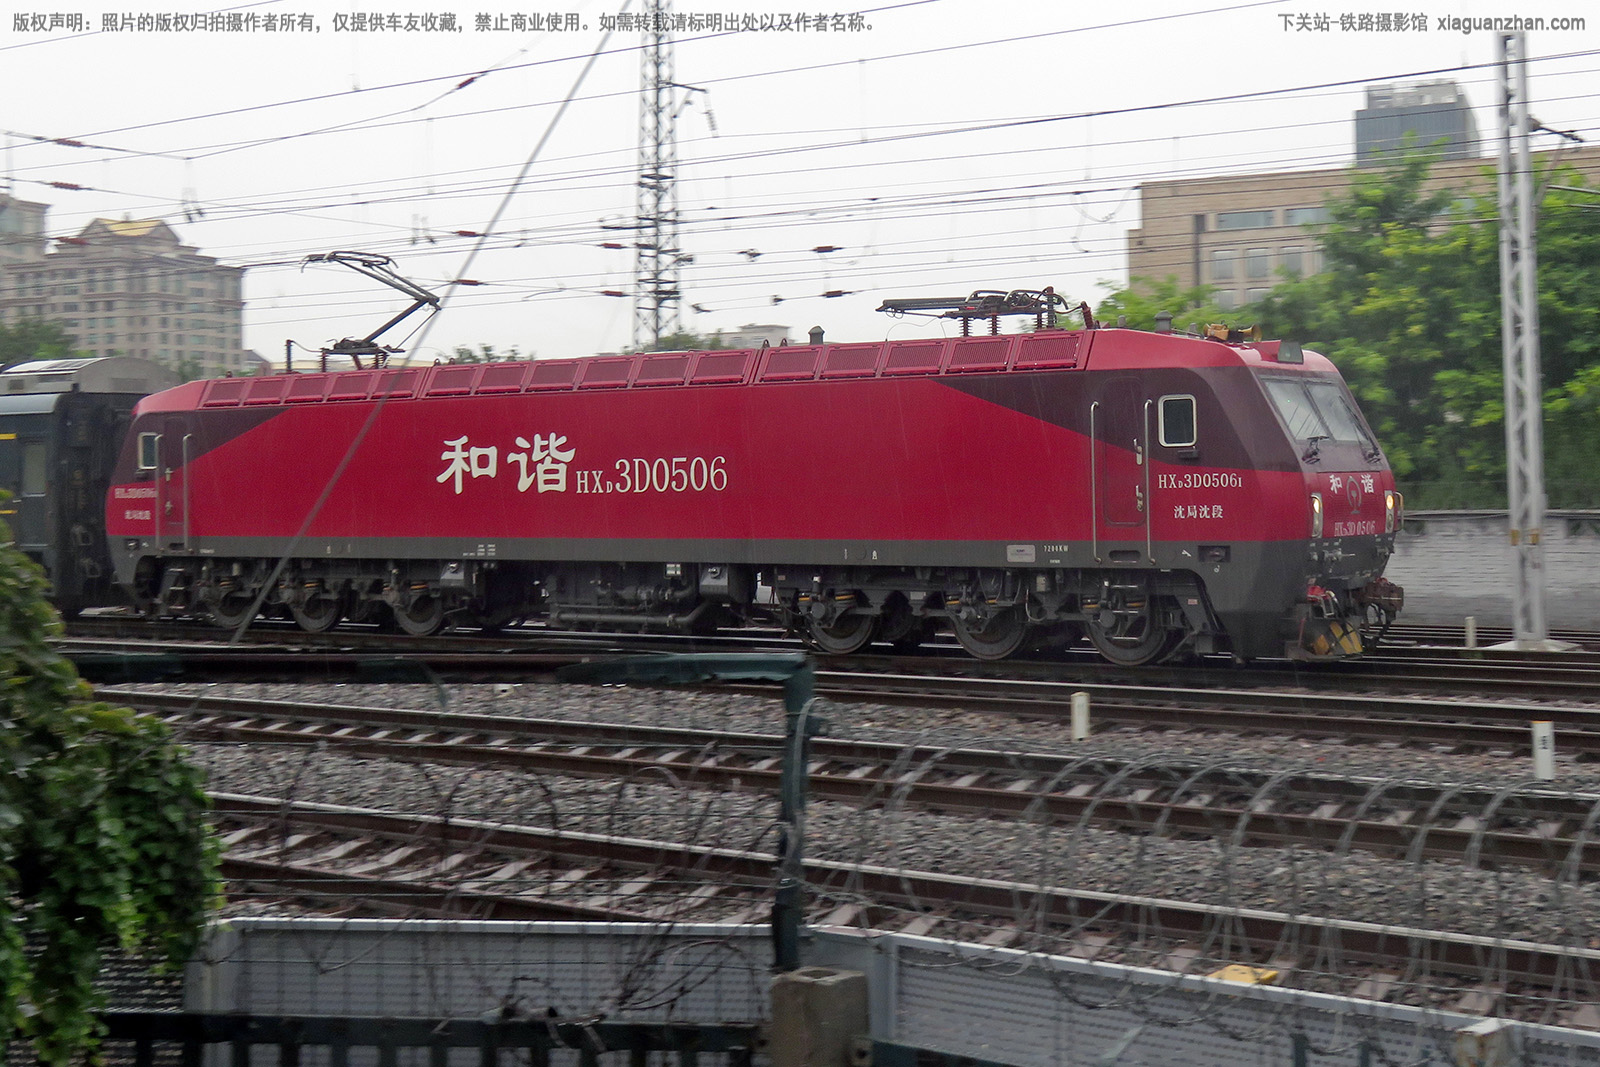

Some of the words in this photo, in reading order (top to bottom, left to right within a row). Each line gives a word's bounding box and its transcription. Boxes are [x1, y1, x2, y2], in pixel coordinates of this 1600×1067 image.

[436, 432, 576, 494] 和谐
[1174, 504, 1224, 519] 沈局沈段
